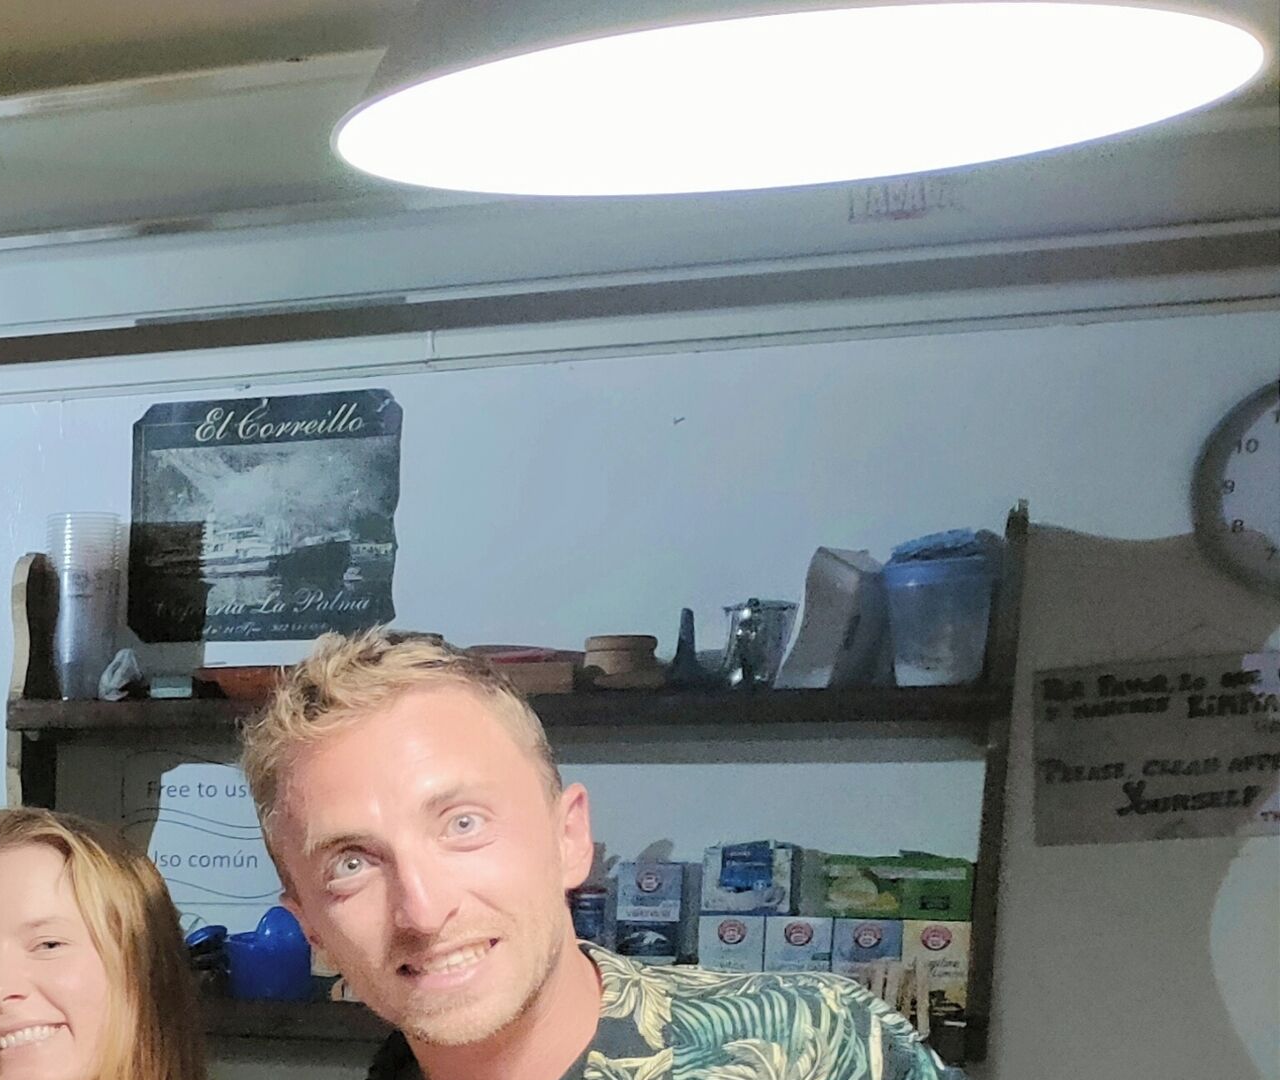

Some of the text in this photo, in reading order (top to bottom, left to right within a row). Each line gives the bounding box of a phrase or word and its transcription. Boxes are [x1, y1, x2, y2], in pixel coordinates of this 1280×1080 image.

[195, 401, 364, 442] El Correillo
[1236, 437, 1260, 454] 10
[1223, 478, 1236, 495] 9
[1231, 518, 1245, 534] 8
[252, 588, 287, 615] La
[292, 588, 371, 613] Palma
[147, 780, 248, 799] Free to us
[187, 850, 258, 869] común
